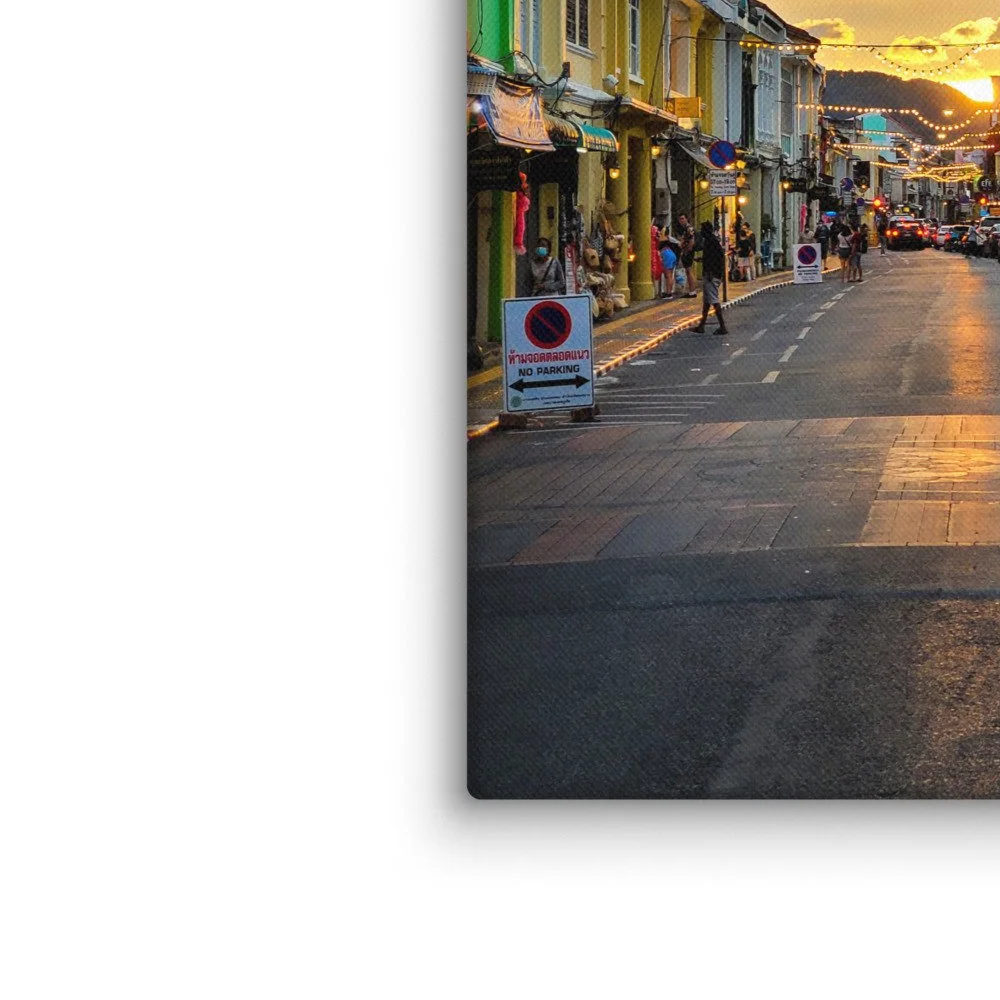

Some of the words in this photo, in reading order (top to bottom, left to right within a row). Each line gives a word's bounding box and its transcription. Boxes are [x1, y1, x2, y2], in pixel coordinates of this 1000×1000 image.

[508, 349, 590, 365] ห้ามจอดตลอดแนว
[518, 367, 533, 377] NO
[536, 364, 580, 376] PARKING
